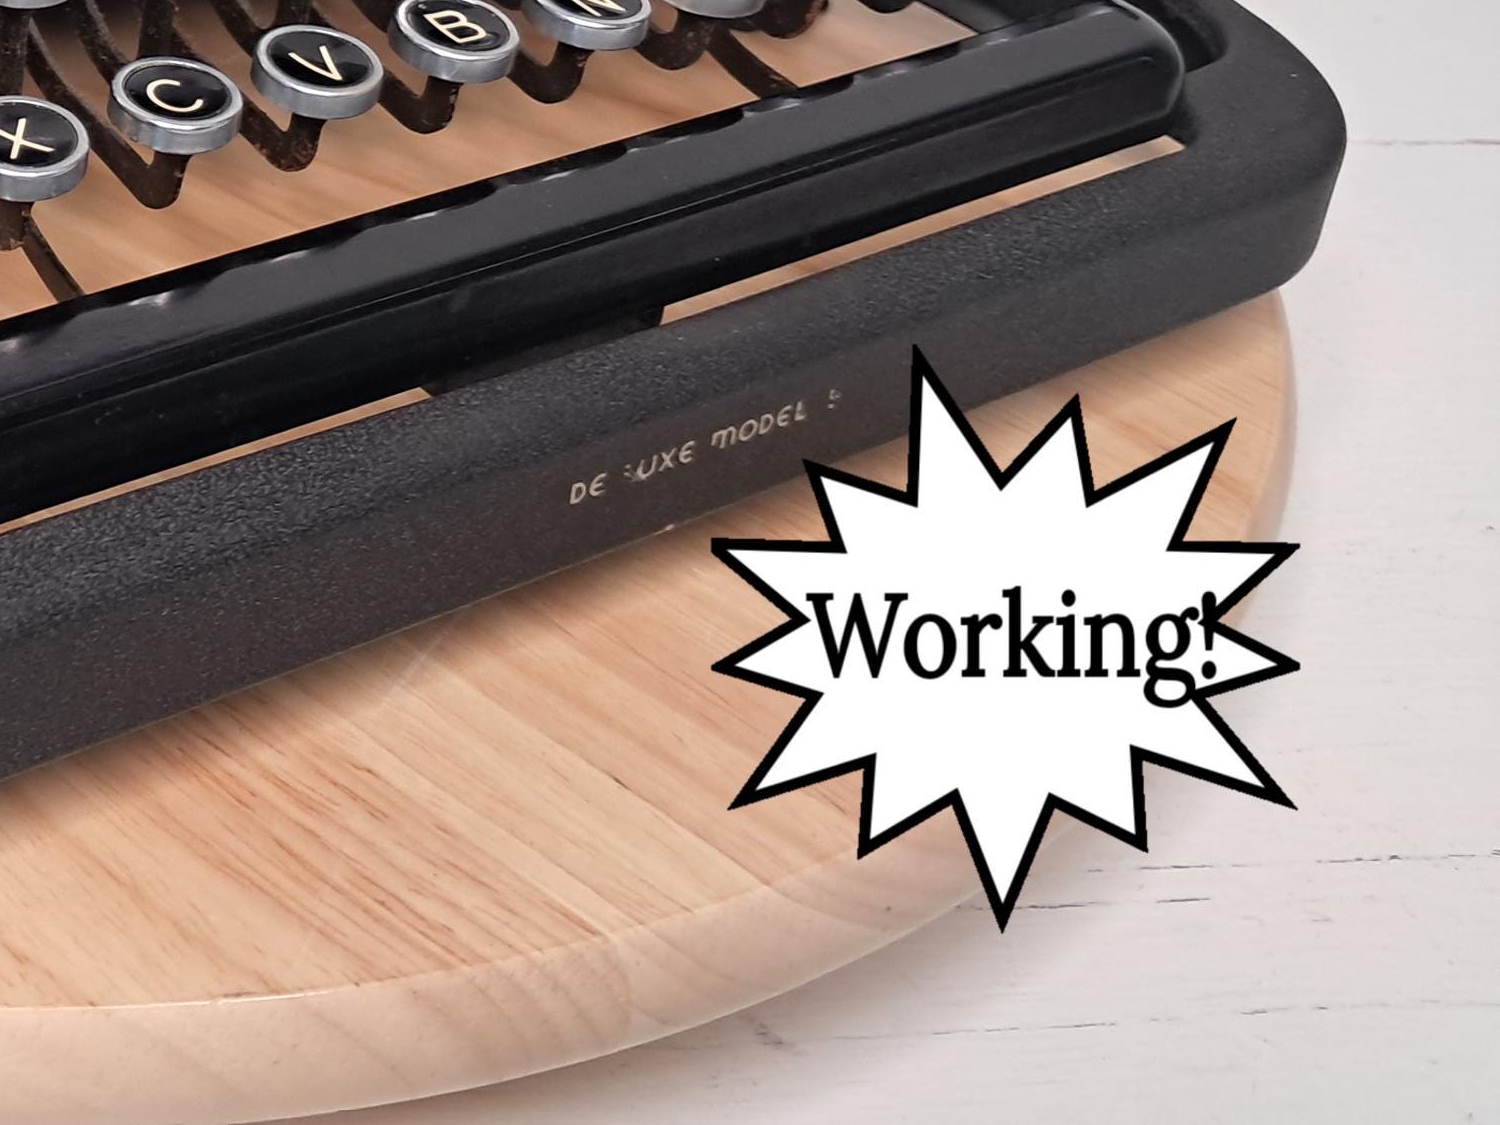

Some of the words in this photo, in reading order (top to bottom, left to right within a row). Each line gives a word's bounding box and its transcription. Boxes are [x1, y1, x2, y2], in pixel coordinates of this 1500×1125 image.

[424, 10, 487, 44] B
[287, 44, 345, 82] V
[145, 78, 205, 113] C
[568, 472, 608, 505] DE
[623, 440, 696, 483] UXE
[711, 400, 807, 450] MODEL
